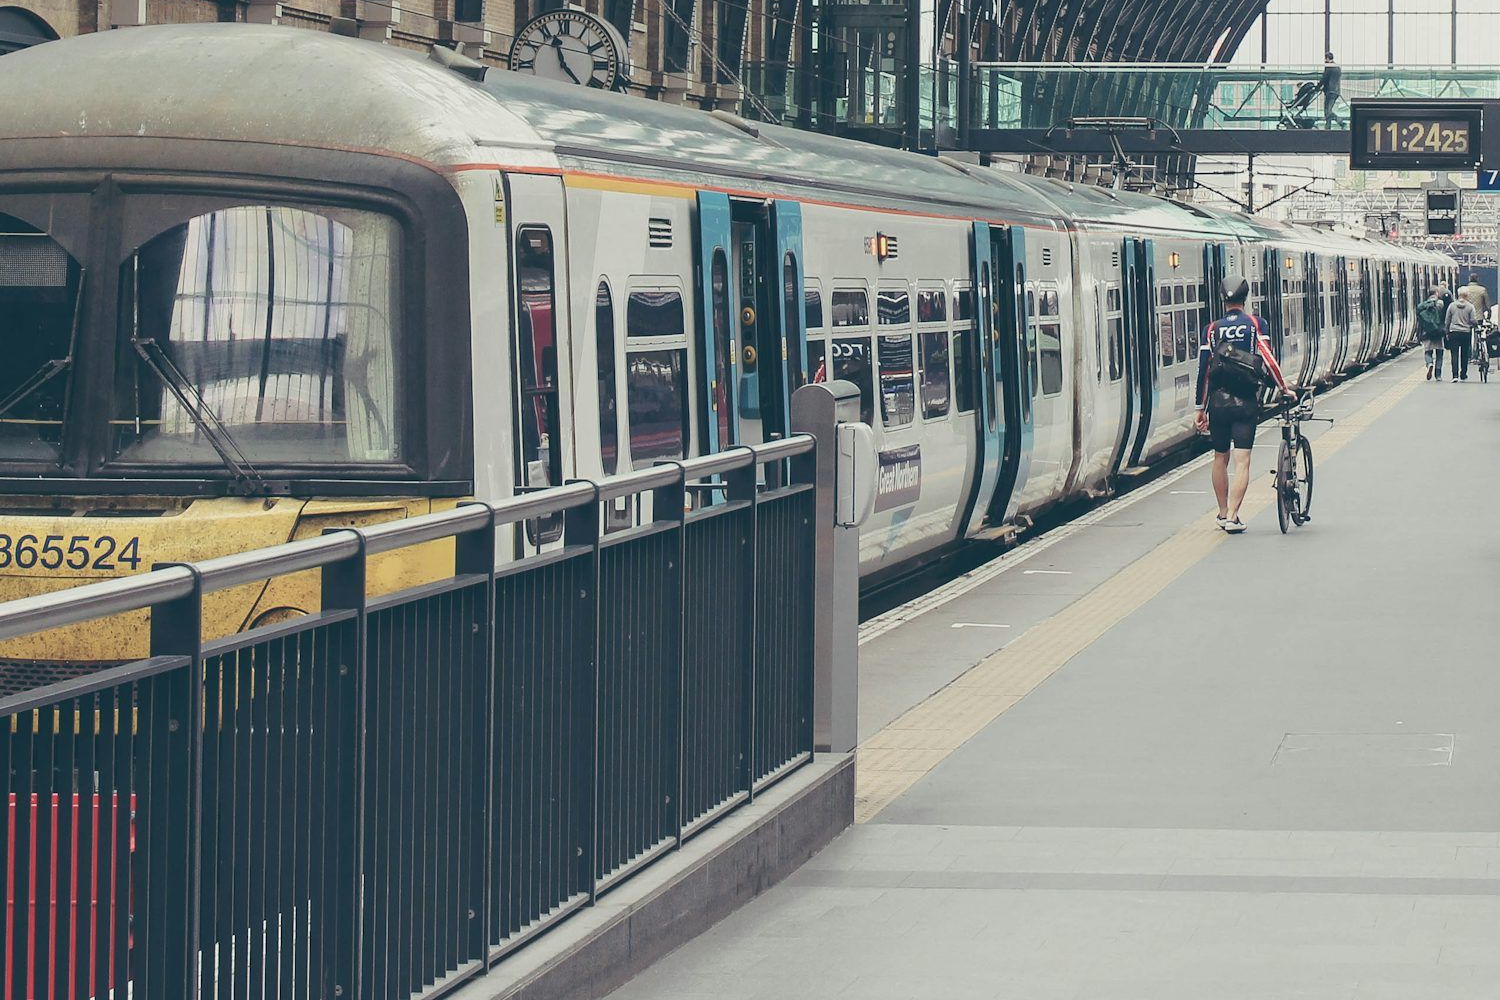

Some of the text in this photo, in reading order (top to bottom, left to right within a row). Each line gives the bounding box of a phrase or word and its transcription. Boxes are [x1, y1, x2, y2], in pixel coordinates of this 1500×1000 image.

[1487, 170, 1498, 185] 7
[1219, 325, 1247, 339] TCC
[880, 460, 919, 495] Great Northern
